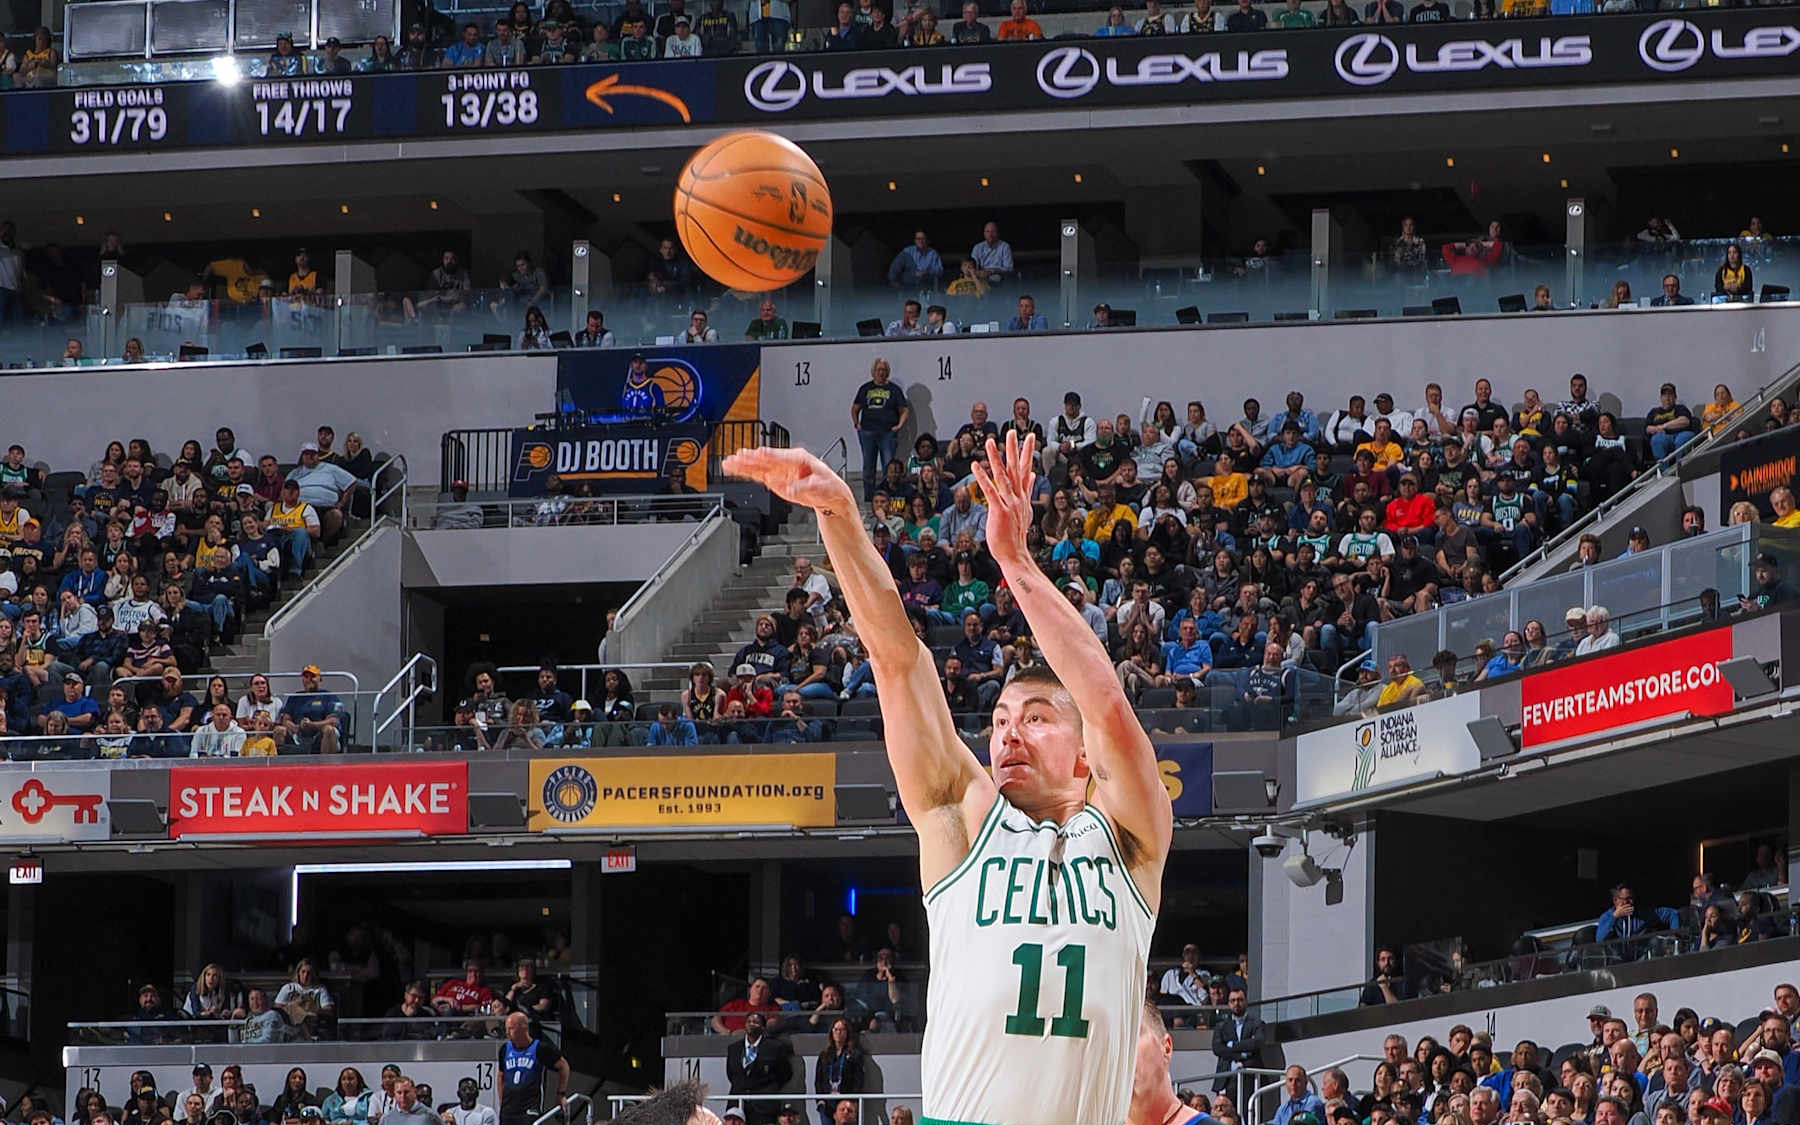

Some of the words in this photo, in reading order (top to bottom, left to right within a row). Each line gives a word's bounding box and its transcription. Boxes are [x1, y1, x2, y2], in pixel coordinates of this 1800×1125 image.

[1106, 49, 1289, 85] LEXUS
[1405, 35, 1592, 72] LEXUS
[253, 82, 288, 100] FREE
[292, 79, 353, 98] THROWS
[448, 72, 507, 91] 3-POINT
[510, 71, 529, 88] FG
[812, 63, 992, 99] LEXUS
[75, 91, 114, 109] FIELD
[117, 87, 164, 107] GOALS
[441, 89, 538, 128] 13/38
[70, 107, 167, 145] 31/79
[255, 98, 352, 137] 14/17
[795, 361, 811, 386] 13
[937, 356, 952, 381] 14
[556, 440, 579, 472] DJ
[585, 438, 658, 471] BOOTH
[1380, 711, 1415, 732] INDIANA
[1380, 725, 1417, 746] SOYBEAN
[1380, 740, 1417, 760] ALLIANCE
[179, 785, 294, 818] STEAK
[301, 789, 319, 812] N
[328, 782, 451, 816] SHAKE
[602, 784, 824, 801] PACERSFOUNDATION.org
[658, 804, 685, 815] Est.
[688, 803, 722, 814] 1993
[608, 854, 630, 869] EXIT
[975, 855, 1117, 931] CELTICS
[1004, 942, 1090, 1039] 11
[1485, 1011, 1497, 1042] 14
[476, 1063, 493, 1091] 13
